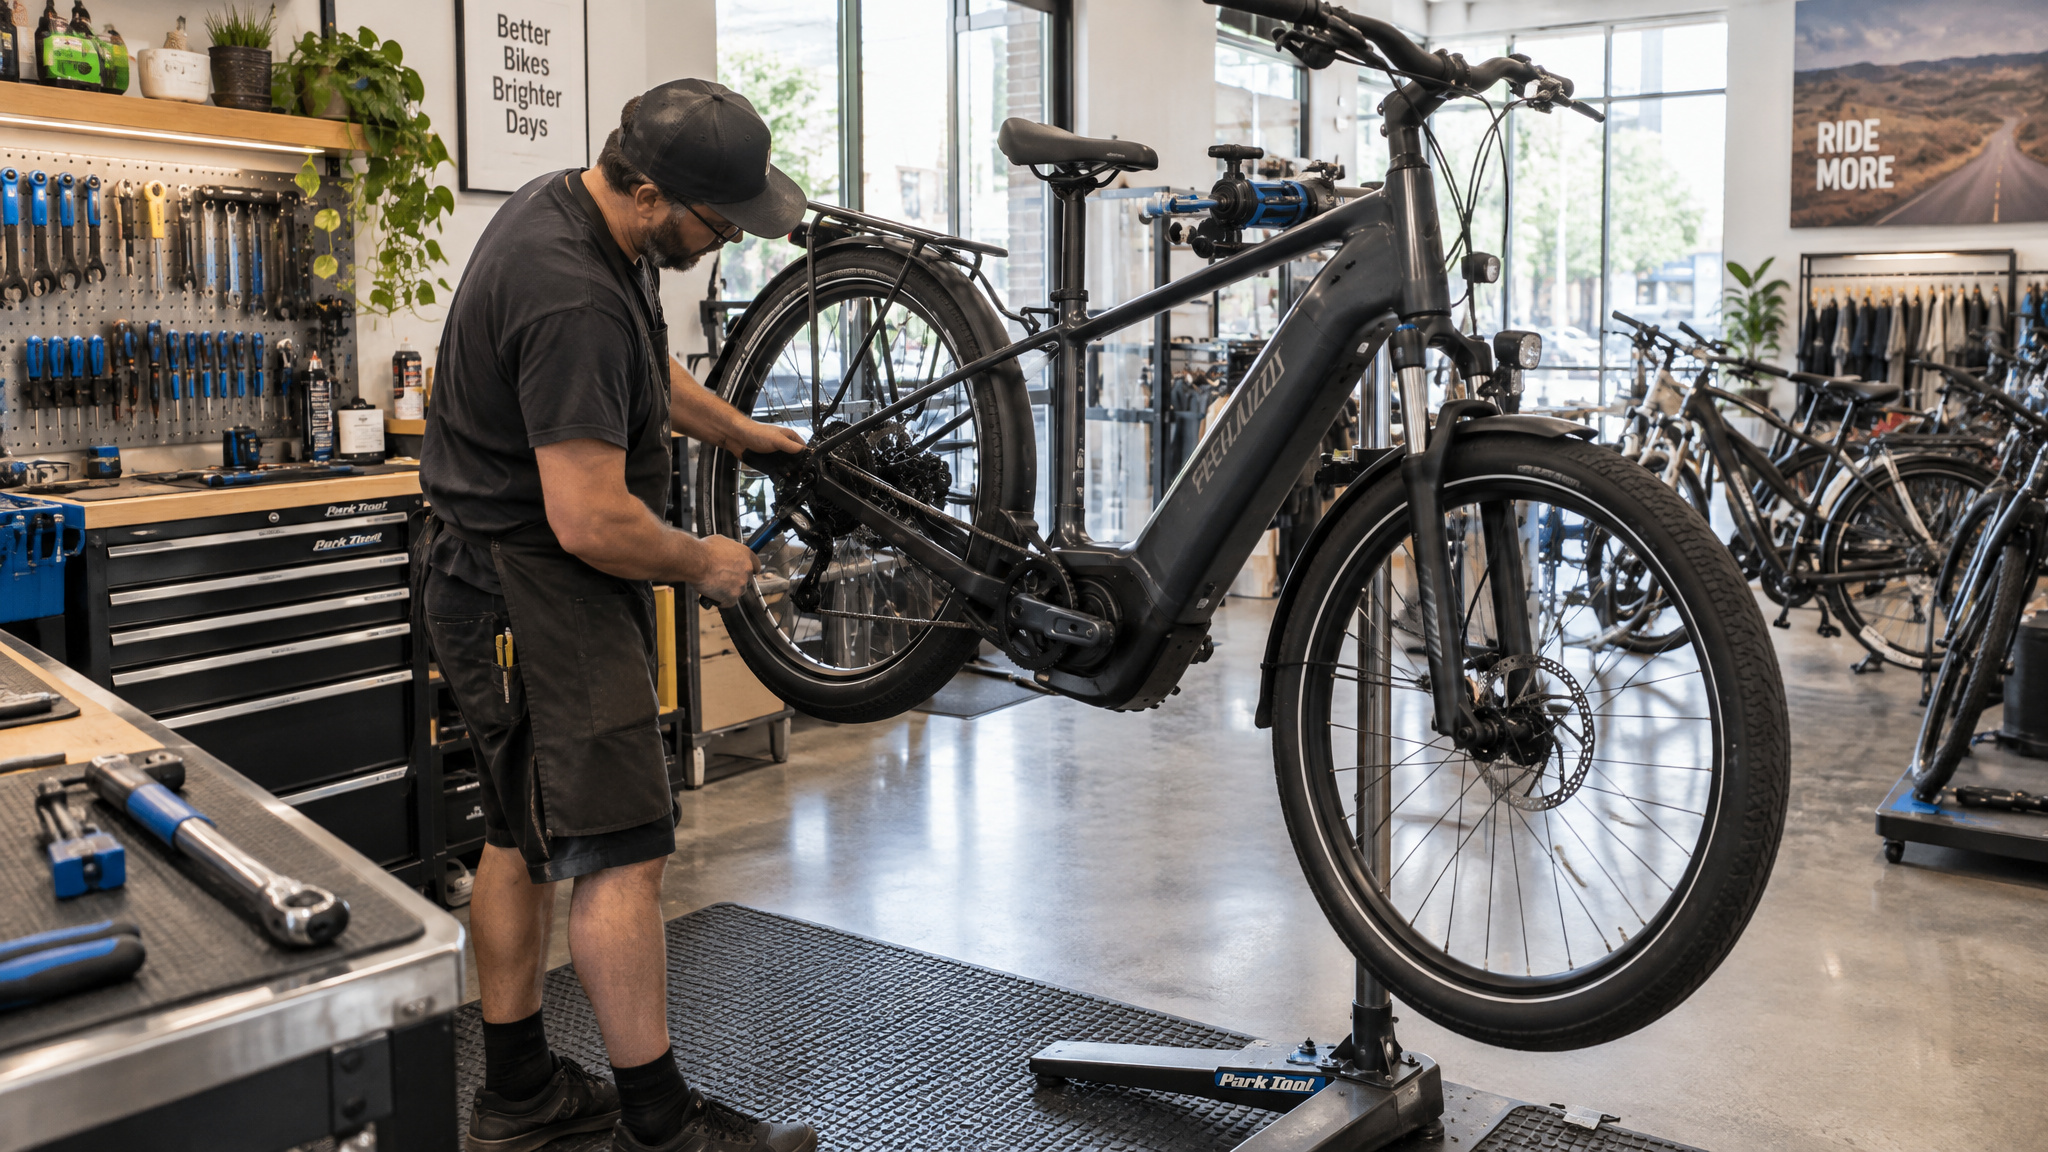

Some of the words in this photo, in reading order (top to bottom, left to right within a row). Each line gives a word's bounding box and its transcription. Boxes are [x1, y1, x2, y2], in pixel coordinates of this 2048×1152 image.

[497, 13, 551, 46] Better
[504, 45, 550, 76] Bikes
[492, 75, 562, 110] Brighter
[506, 108, 548, 141] Days
[1817, 118, 1881, 154] RIDE
[1816, 155, 1895, 191] MORE
[1219, 1073, 1267, 1089] Park
